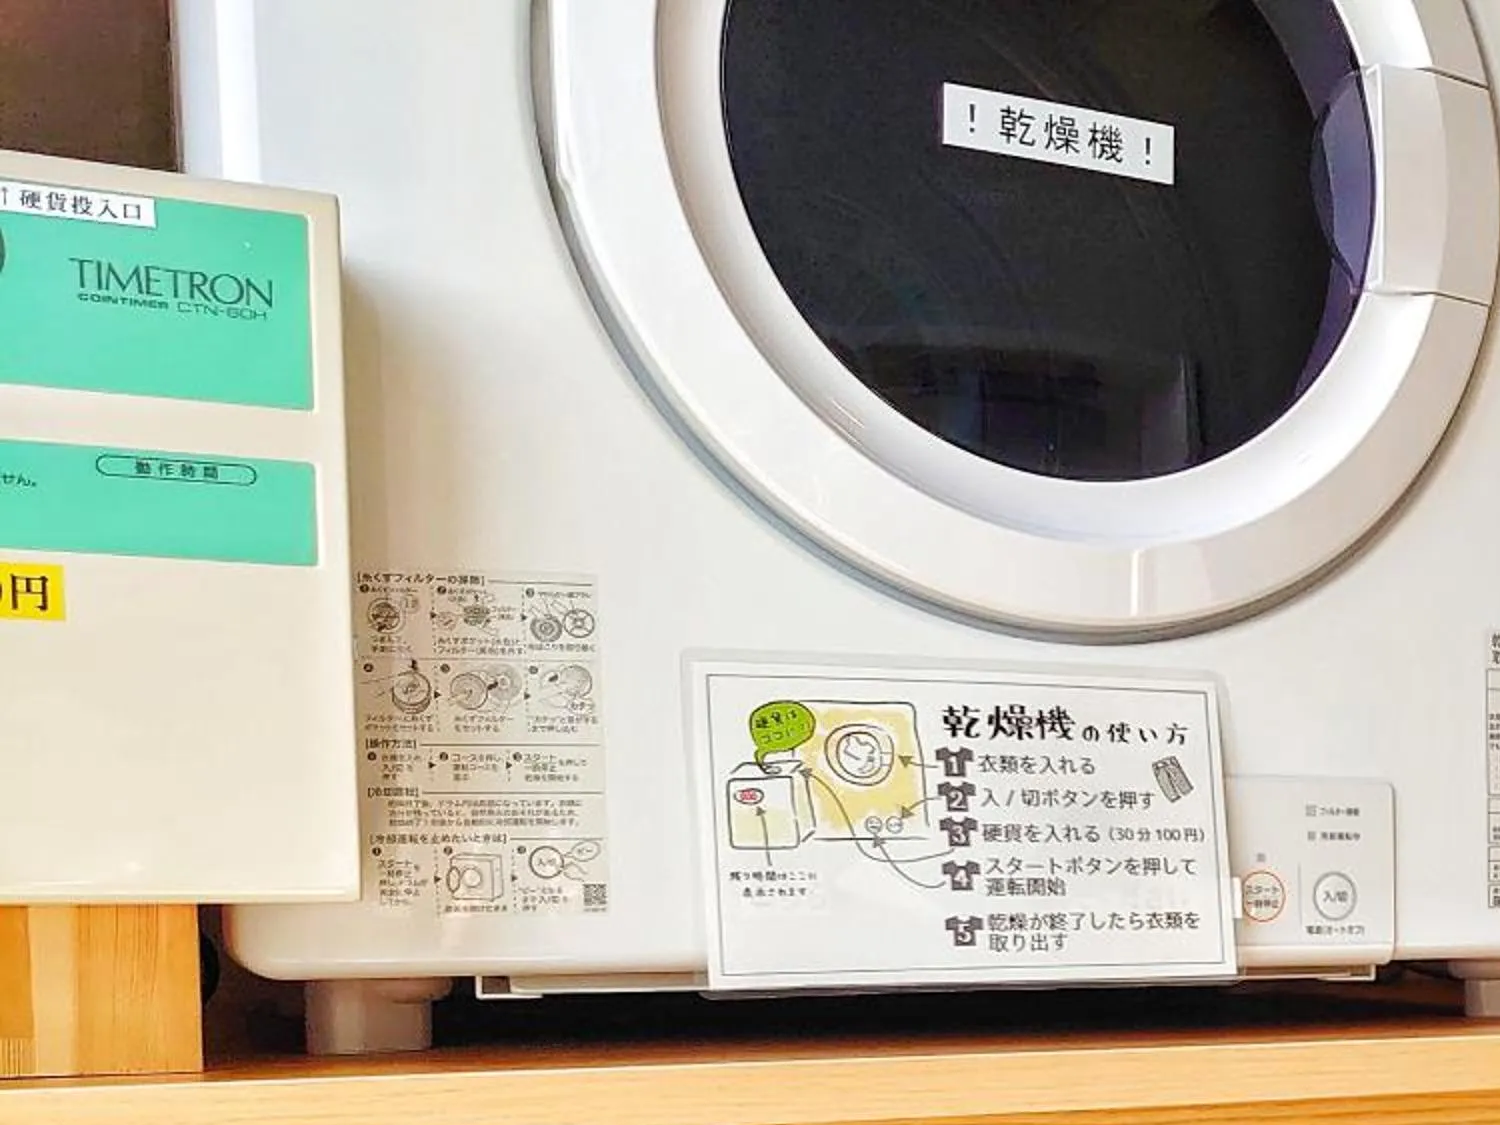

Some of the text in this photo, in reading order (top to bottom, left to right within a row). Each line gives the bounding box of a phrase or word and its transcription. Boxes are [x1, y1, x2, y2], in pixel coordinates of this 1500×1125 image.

[19, 189, 142, 221] 硬貨投入口
[69, 257, 273, 309] TIMETRON
[941, 704, 1189, 746] 乾燥機の使い方
[979, 755, 1096, 777] 衣類を入れる
[986, 857, 1197, 878] スタートボタンを押して
[986, 878, 1067, 897] 運転開始
[987, 911, 1200, 932] 乾燥が終了したら衣類を
[988, 934, 1068, 952] 取り出す
